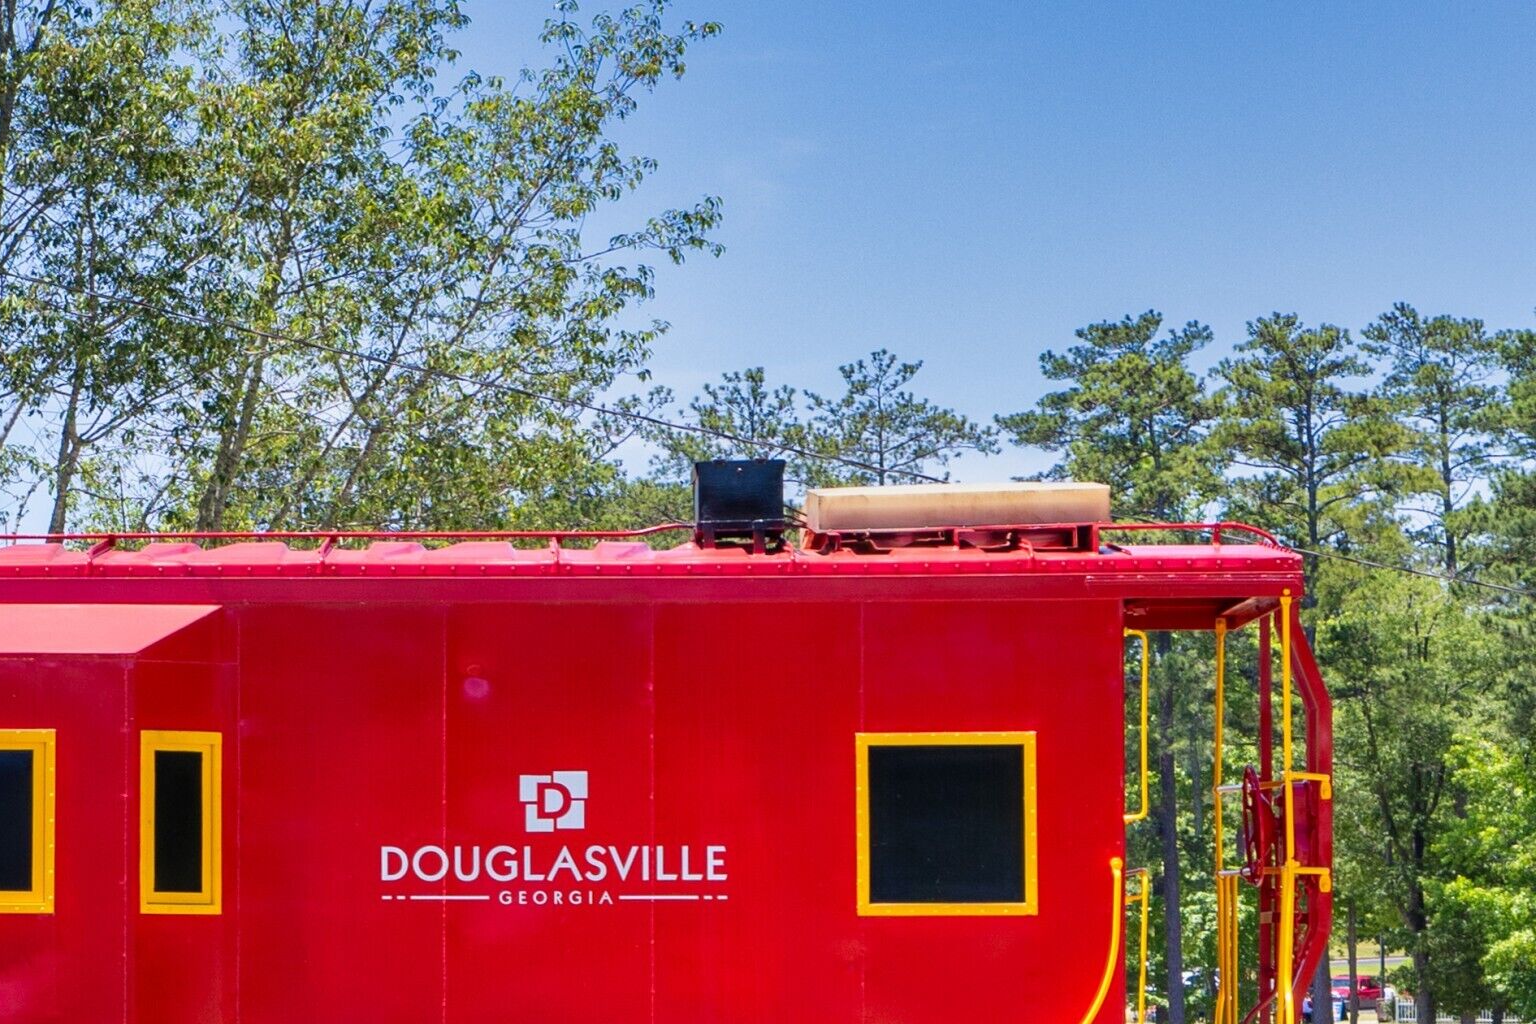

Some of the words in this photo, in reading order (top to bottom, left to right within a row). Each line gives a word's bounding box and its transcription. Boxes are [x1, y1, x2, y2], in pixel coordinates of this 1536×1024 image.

[536, 782, 573, 819] D
[381, 845, 728, 882] DOUGLASVILLE
[498, 890, 614, 905] GEORGIA
